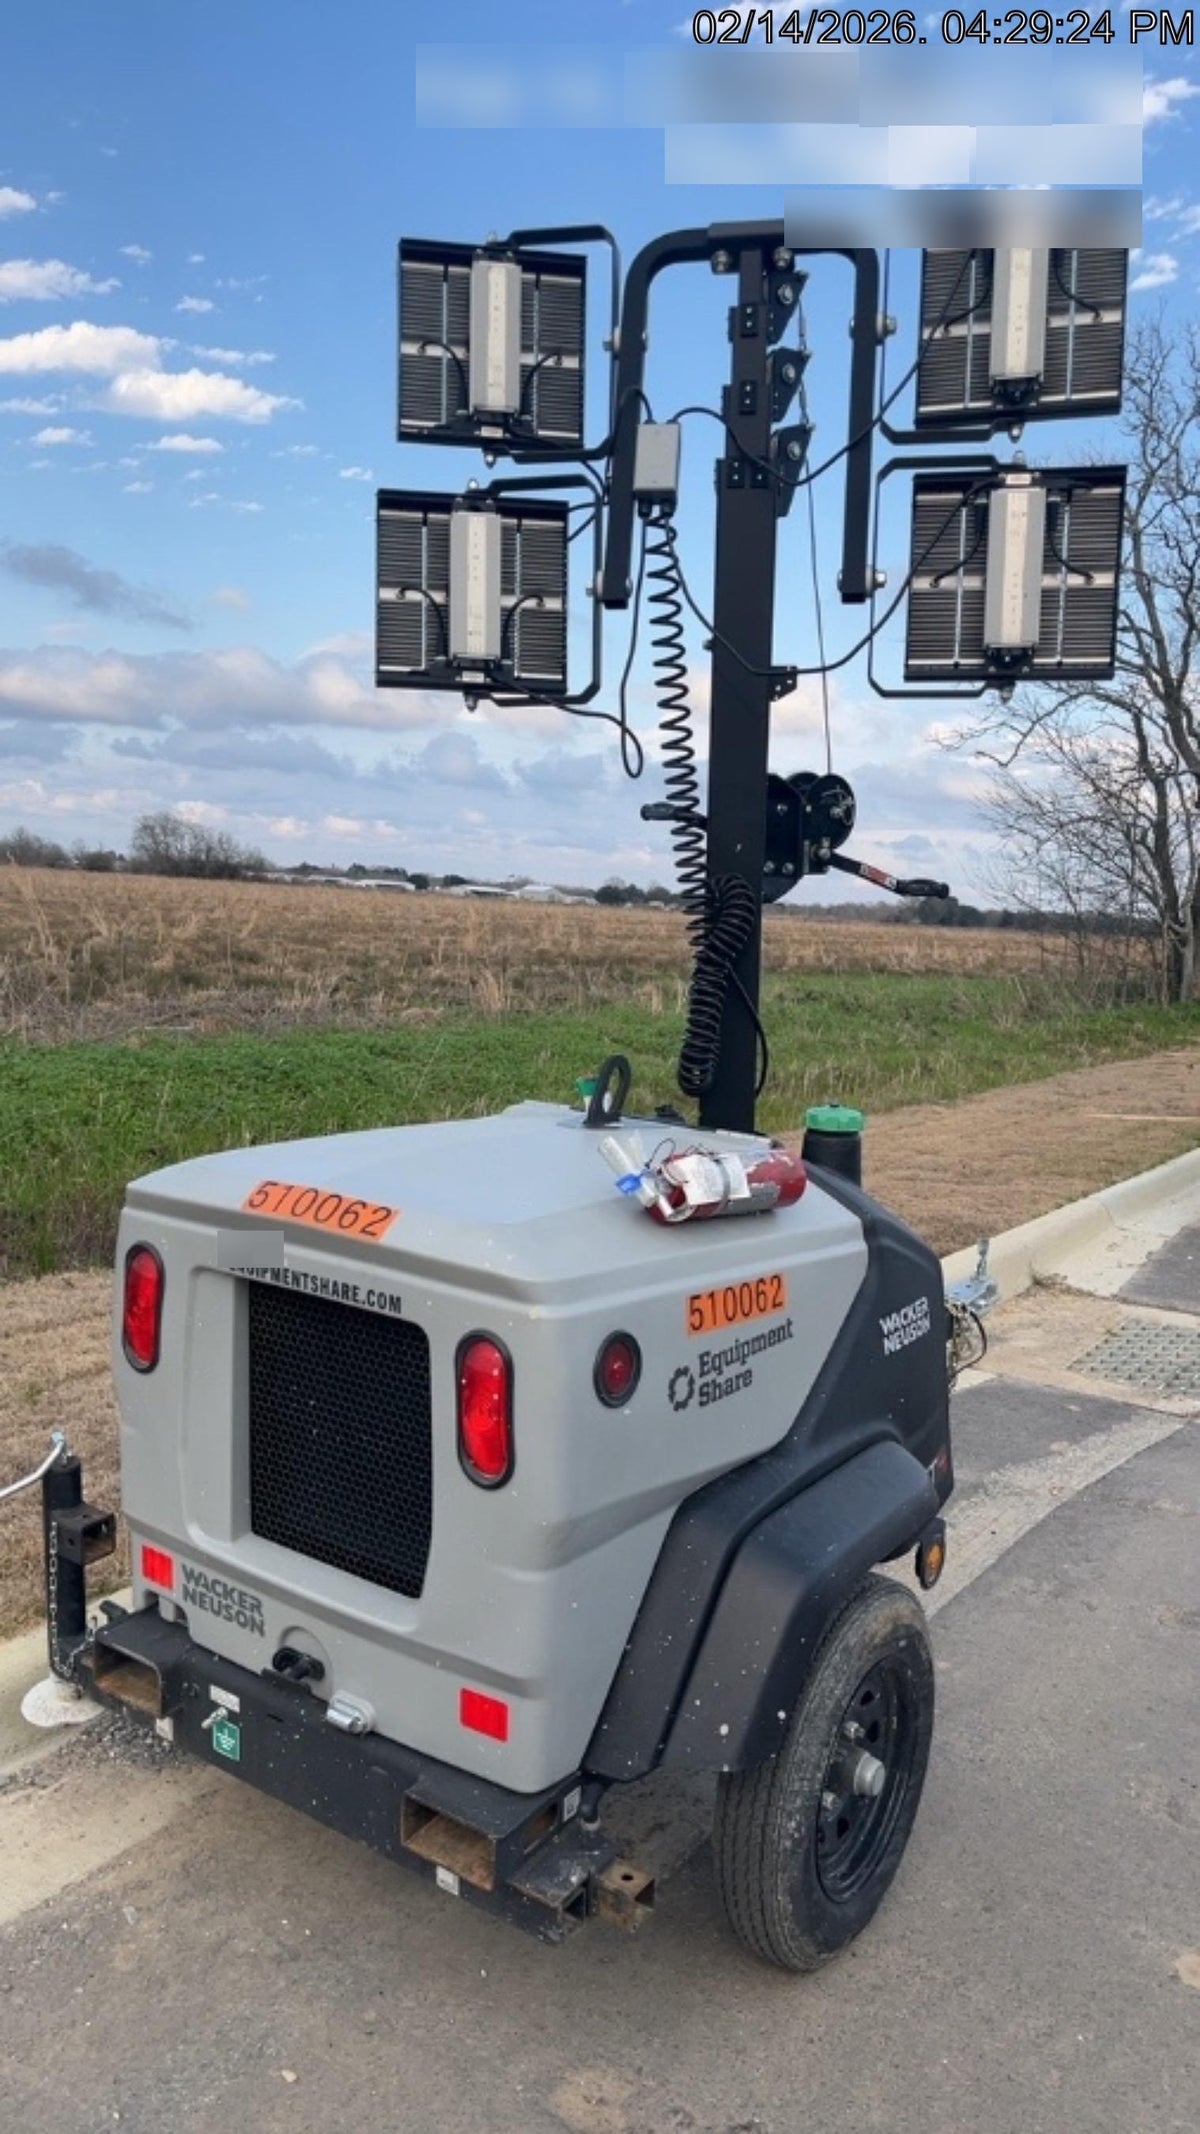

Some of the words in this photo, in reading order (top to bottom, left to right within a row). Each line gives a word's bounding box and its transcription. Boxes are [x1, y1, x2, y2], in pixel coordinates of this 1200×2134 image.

[248, 1180, 392, 1236] 510062
[689, 1275, 783, 1331] 510062
[697, 1317, 793, 1378] Equipment
[698, 1368, 753, 1407] Share
[181, 1563, 264, 1618] WACKER
[182, 1583, 265, 1637] NEUSON
